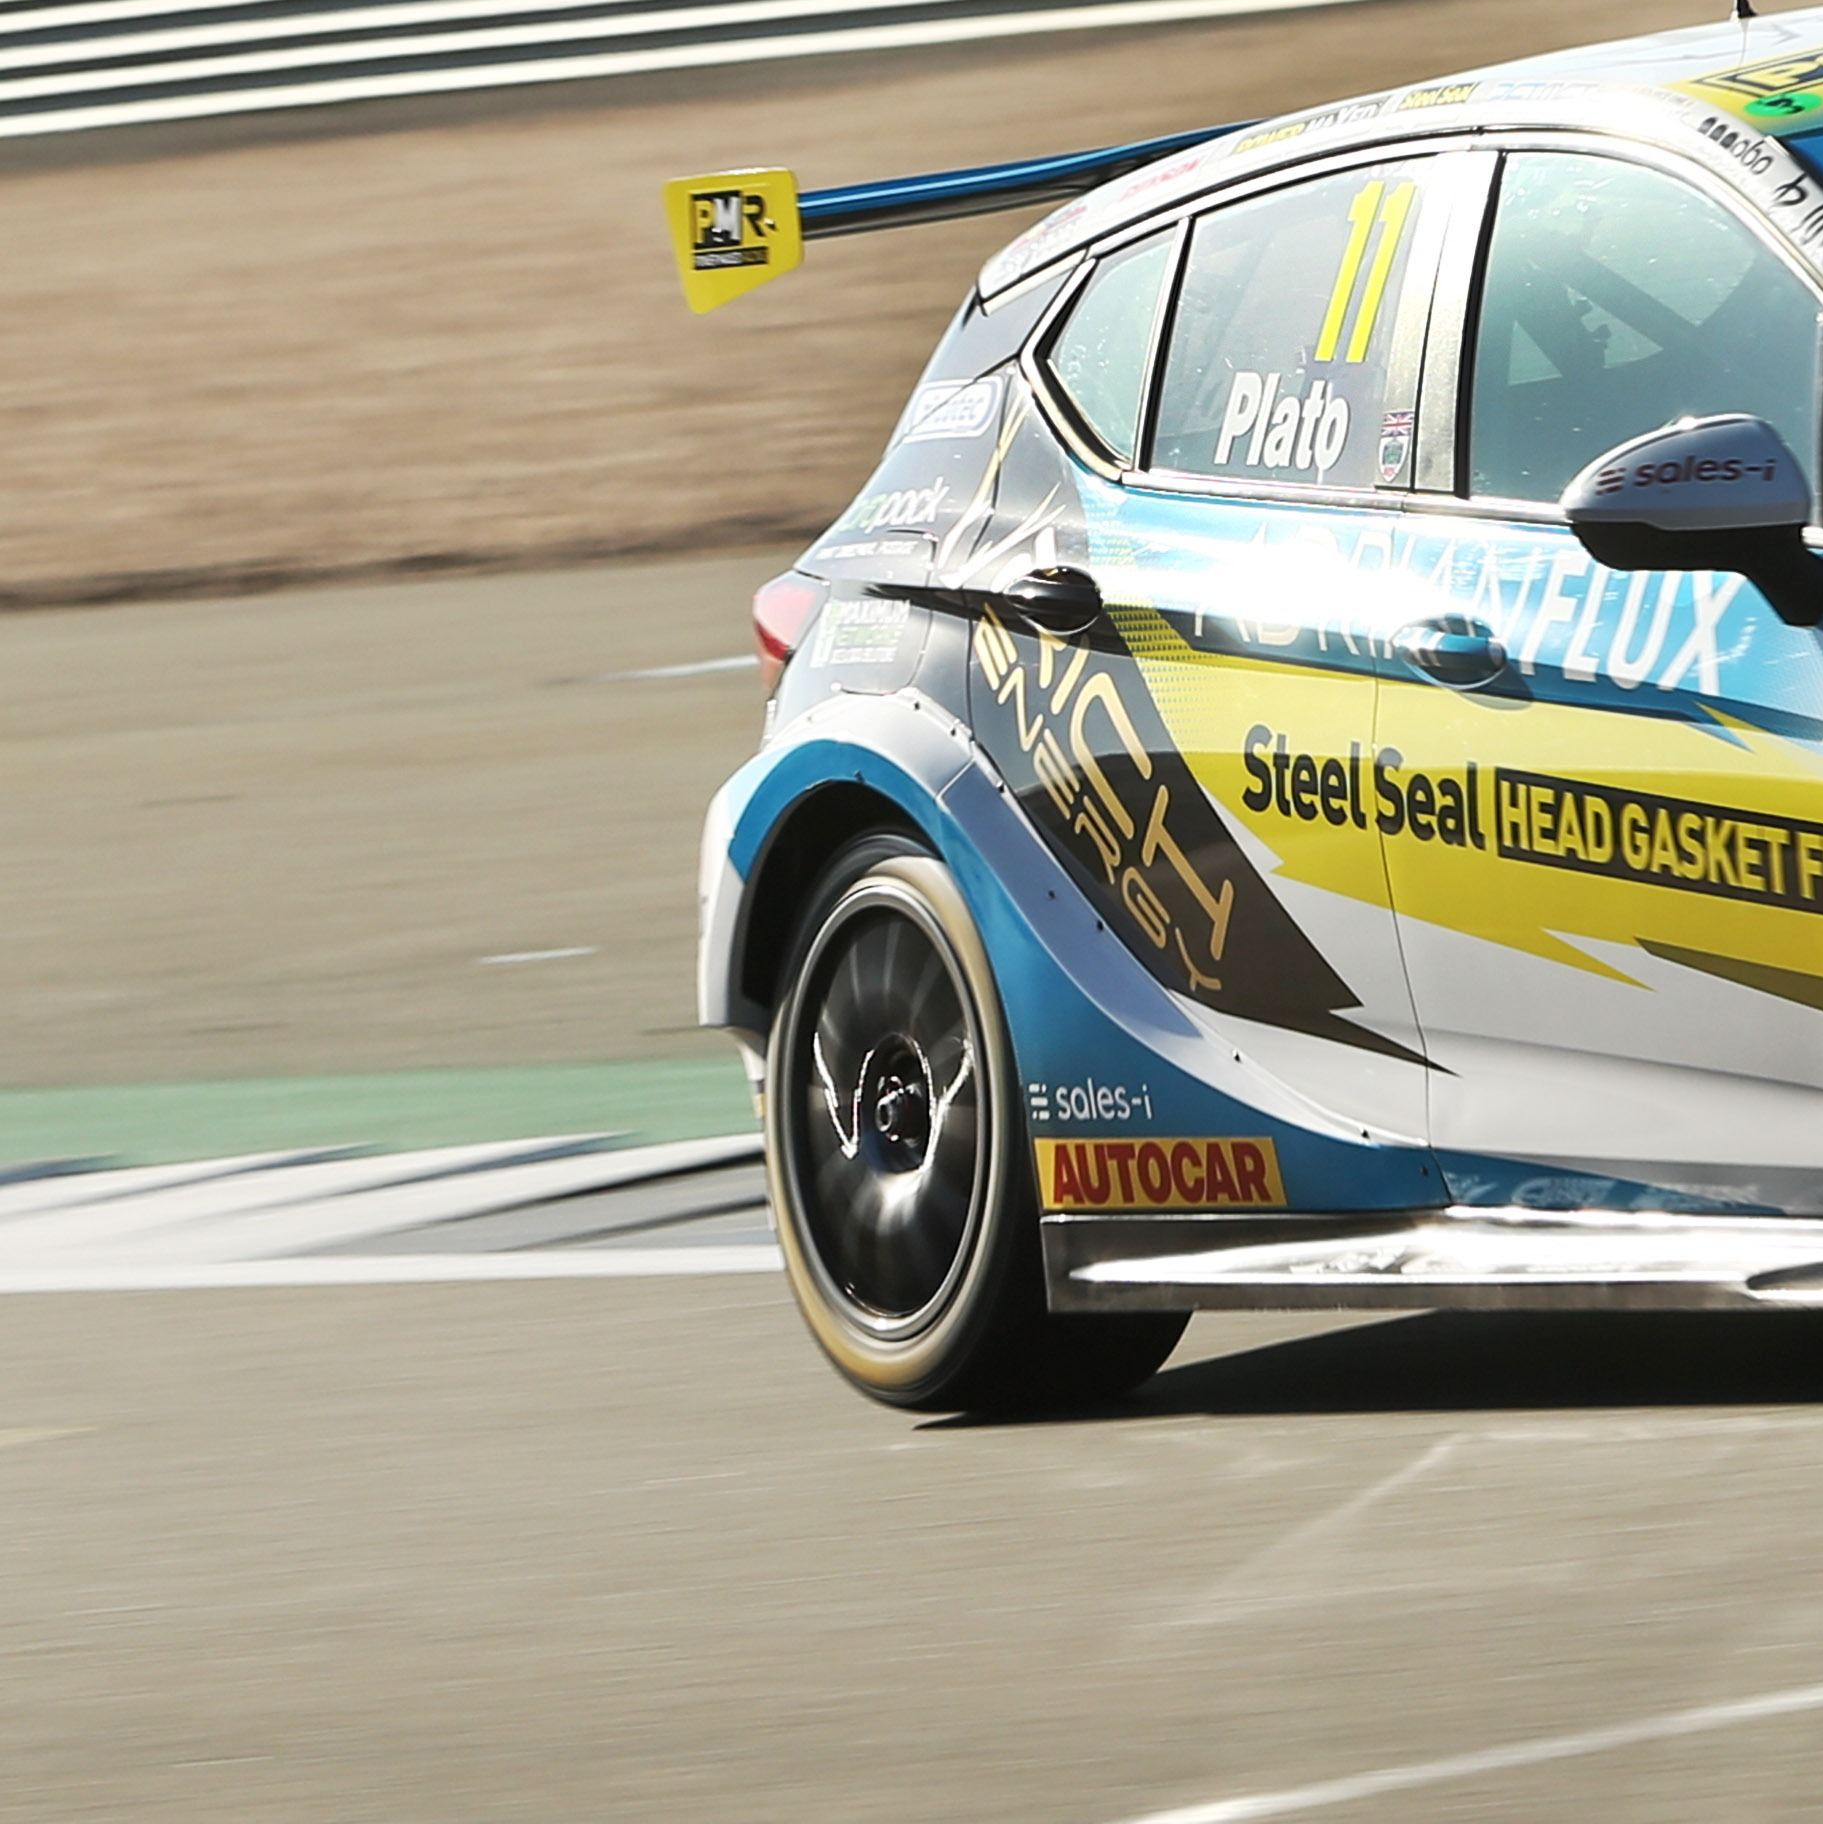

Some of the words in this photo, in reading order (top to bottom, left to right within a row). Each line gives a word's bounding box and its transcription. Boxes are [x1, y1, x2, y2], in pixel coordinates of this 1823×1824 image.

[693, 194, 767, 245] PMR
[1314, 179, 1420, 364] 11
[1213, 369, 1351, 475] Plato
[1632, 455, 1777, 487] sales-i
[973, 601, 1222, 993] ENERGY
[1242, 724, 1366, 829] Steel
[1375, 745, 1486, 852] Seal
[1501, 780, 1612, 865] HEAD
[1619, 804, 1789, 897] GASKET
[1056, 1078, 1153, 1121] sales-i
[1053, 1142, 1270, 1205] AUTOCAR
